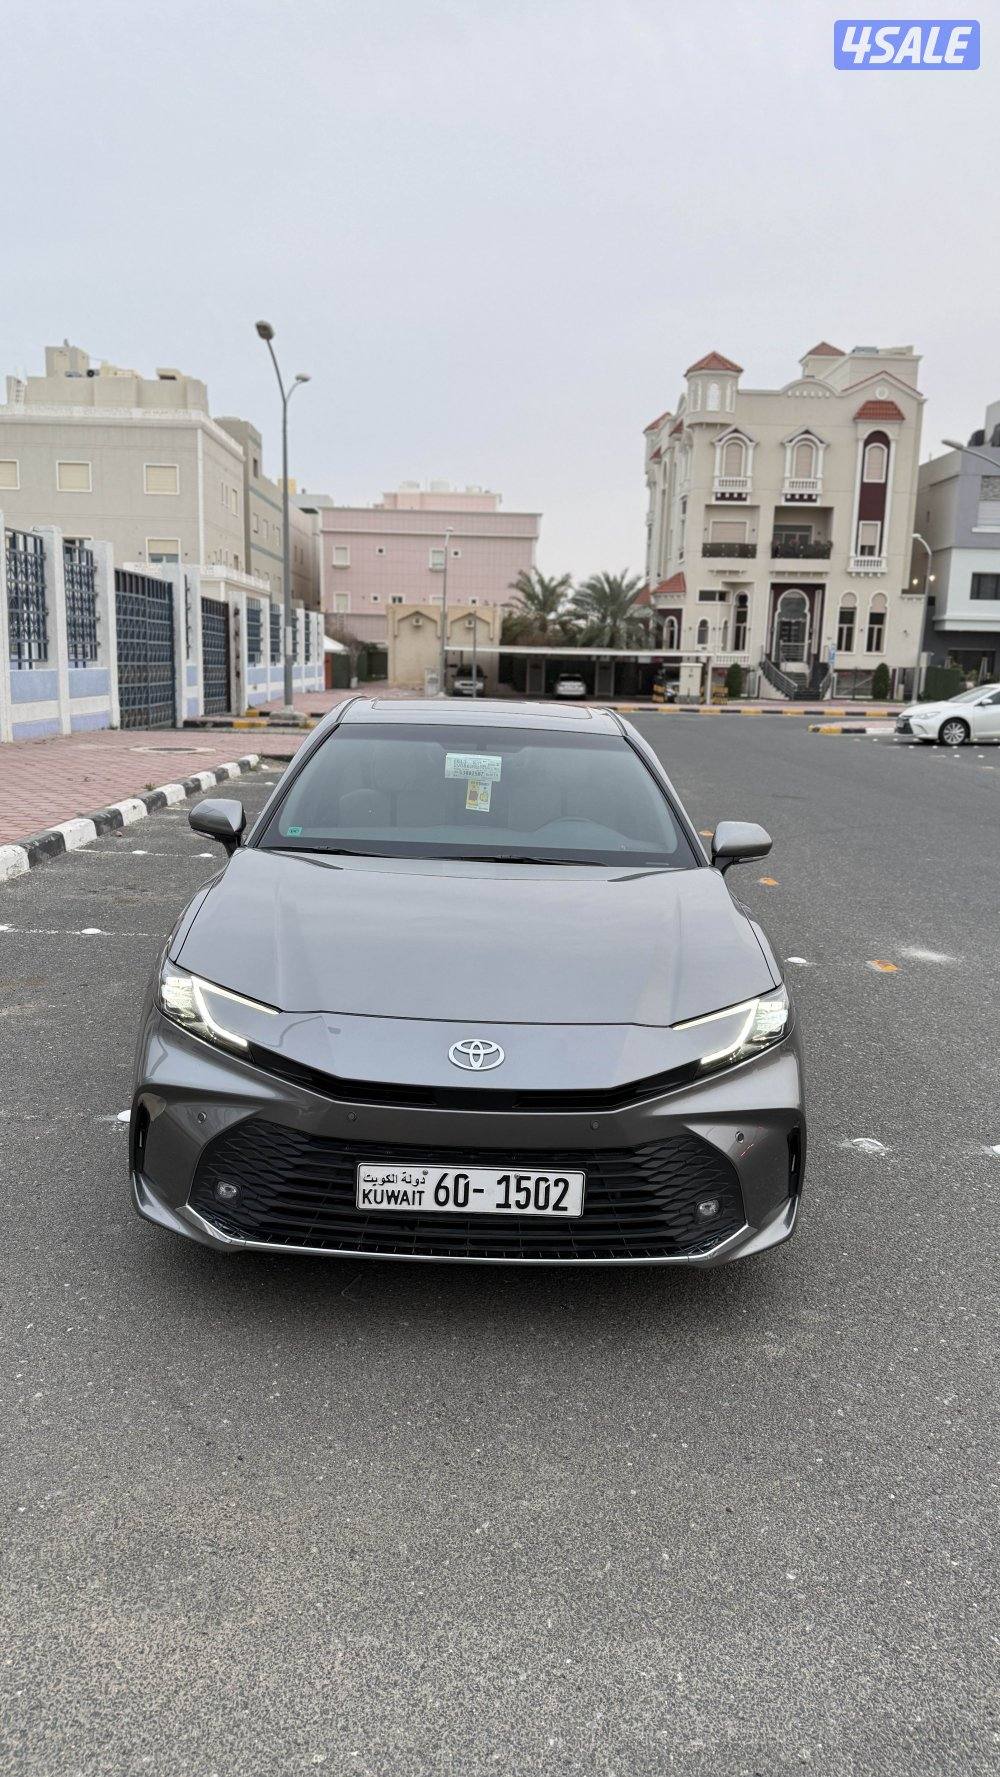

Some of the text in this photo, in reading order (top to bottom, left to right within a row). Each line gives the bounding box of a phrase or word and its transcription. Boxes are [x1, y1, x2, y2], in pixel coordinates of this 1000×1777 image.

[363, 1170, 426, 1187] دولة الكويت
[362, 1188, 426, 1206] KUWAIT
[495, 1174, 570, 1212] 1502
